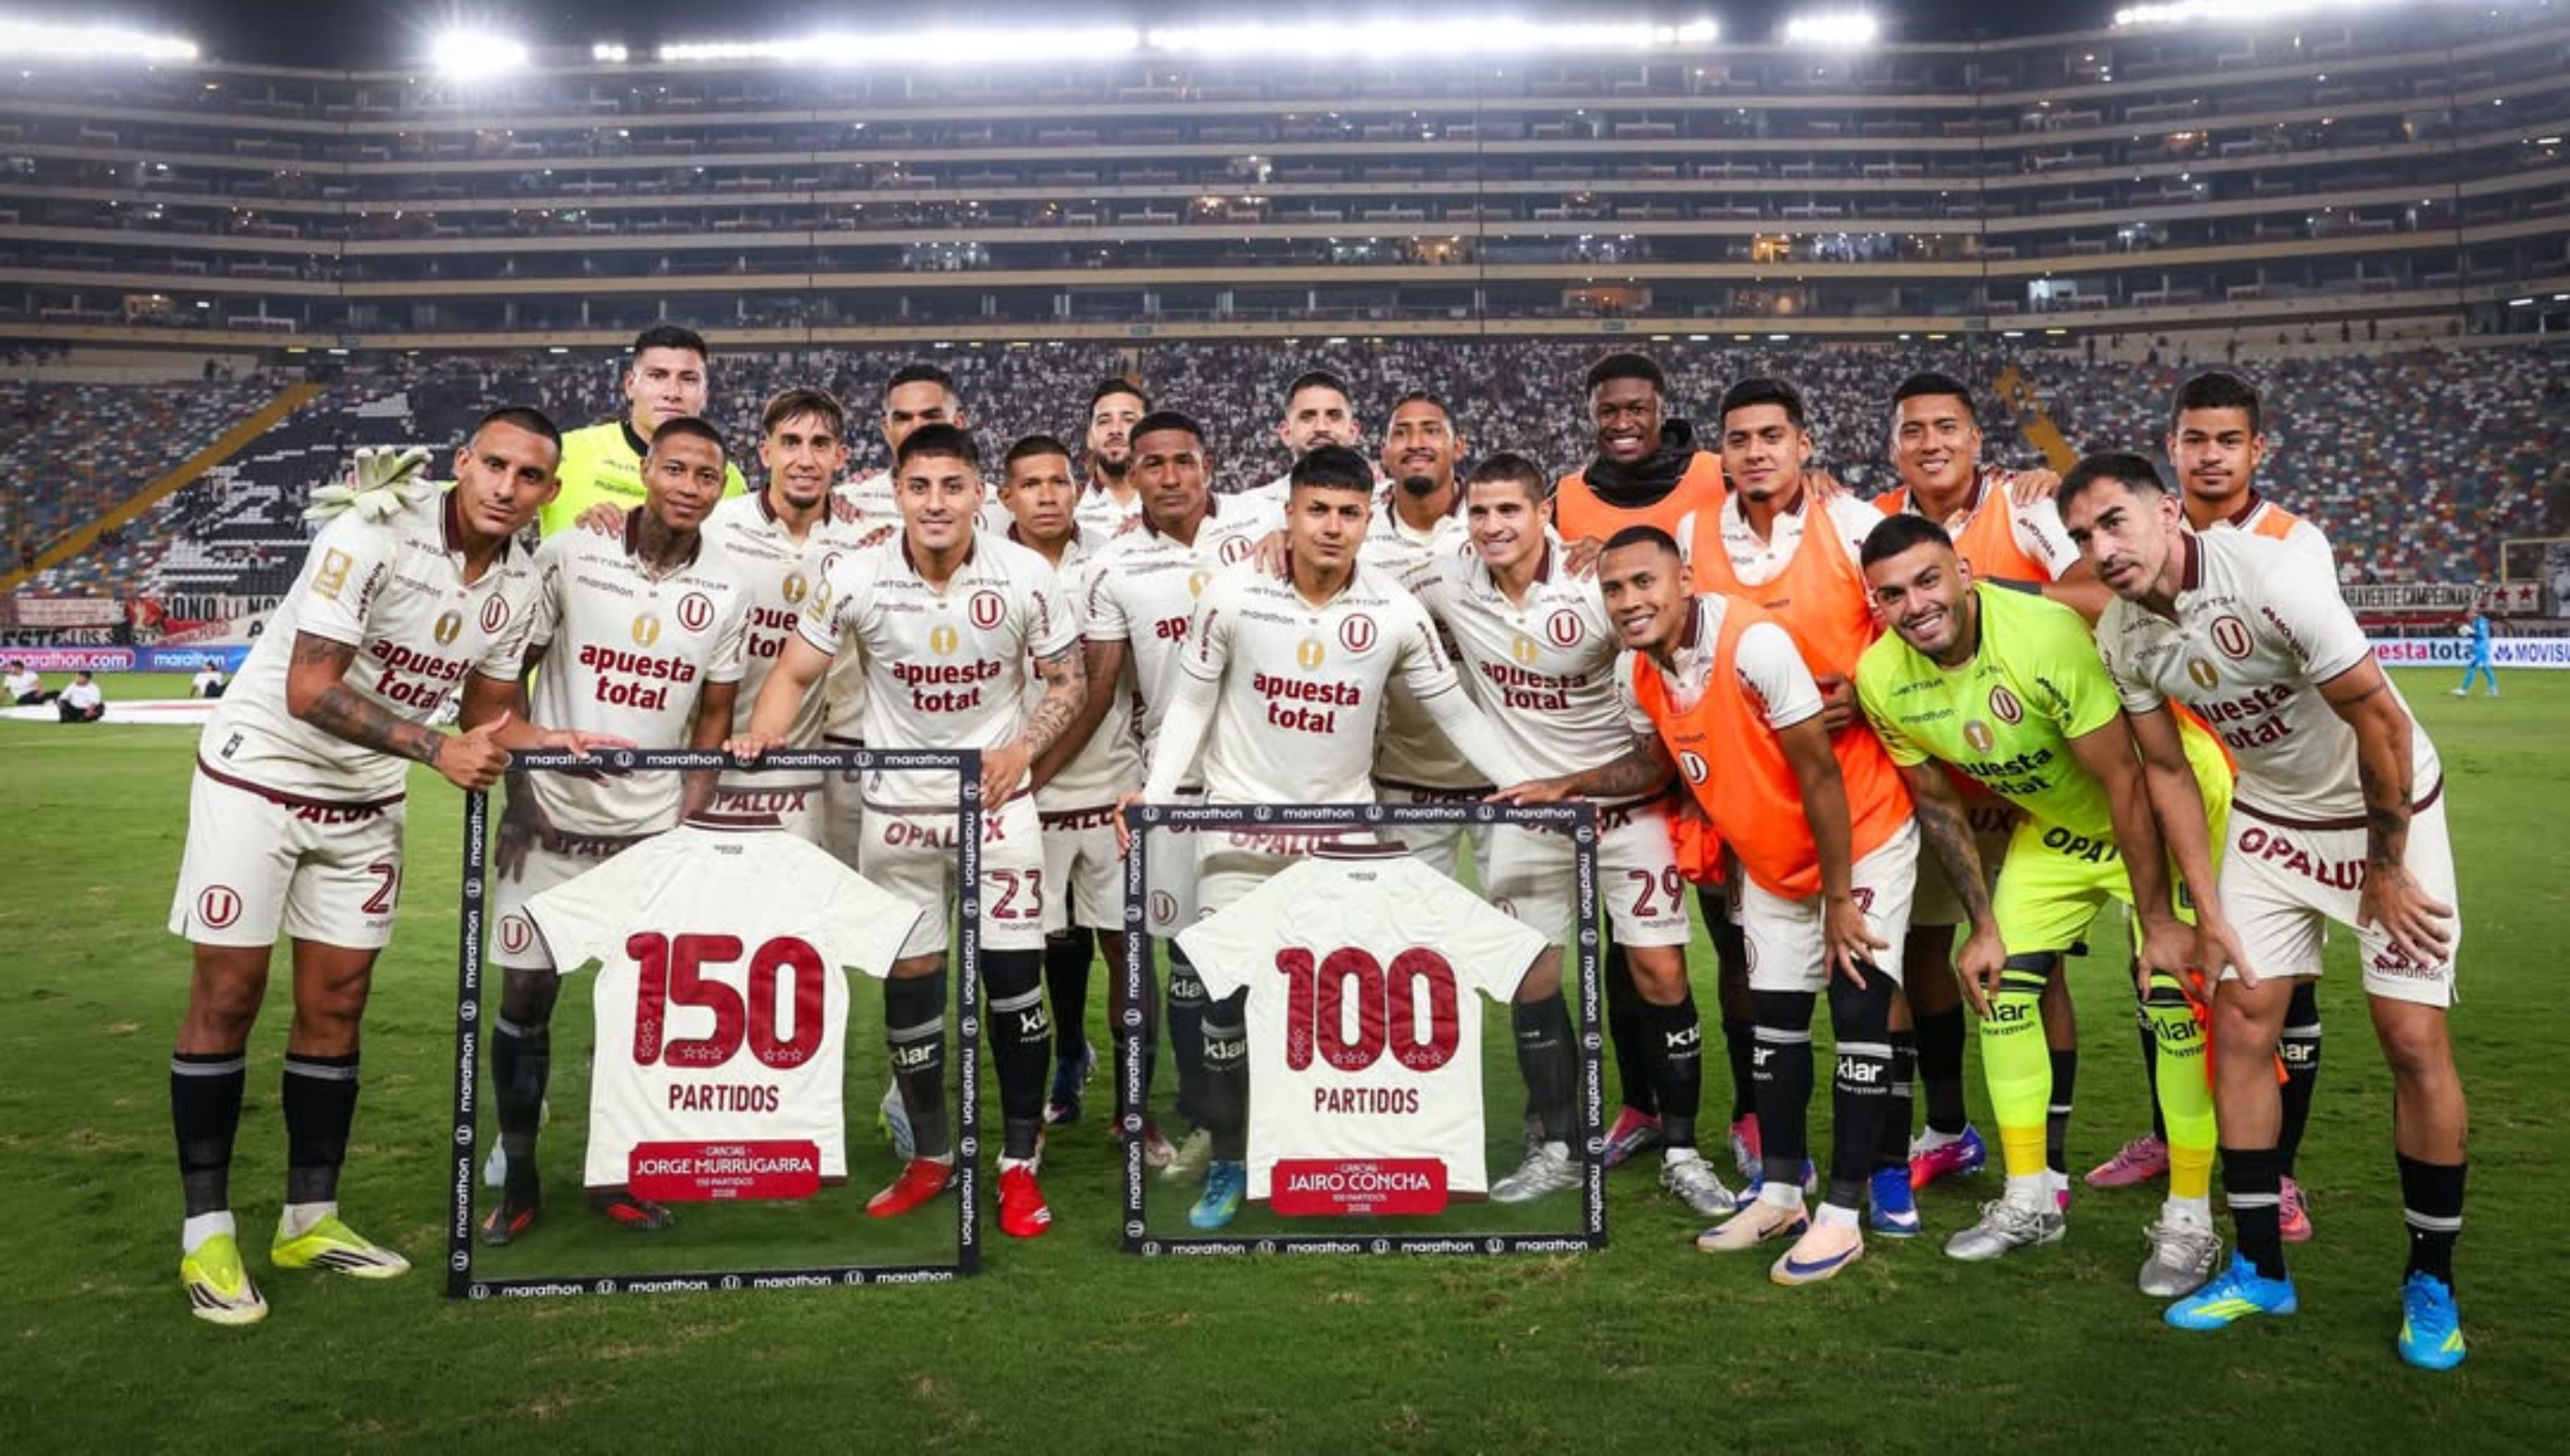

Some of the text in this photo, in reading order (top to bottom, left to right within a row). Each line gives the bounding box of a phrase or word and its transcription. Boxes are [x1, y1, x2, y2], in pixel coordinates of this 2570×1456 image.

[154, 651, 225, 669] marathon
[579, 644, 696, 683] apuesta
[892, 658, 1002, 686] apuesta
[1480, 661, 1588, 687] apuesta
[596, 676, 667, 711] total
[911, 687, 981, 713] total
[1253, 671, 1360, 706] apuesta
[1504, 686, 1571, 710] total
[2189, 682, 2296, 725] puesta
[1267, 702, 1335, 735] total
[2225, 714, 2293, 750] otal
[647, 754, 723, 765] marathon
[766, 754, 842, 765] marathon
[885, 754, 959, 765] marathon
[1171, 808, 1243, 819] marathon
[1283, 808, 1354, 818] marathon
[1394, 808, 1466, 818] marathon
[1506, 809, 1576, 818] marathon
[884, 822, 1005, 849] OPALX
[966, 814, 976, 886] marathon
[1129, 828, 1140, 894] marathon
[990, 869, 1042, 919] 23
[1580, 853, 1593, 919] marathon
[1628, 865, 1684, 917] 29
[466, 911, 478, 987] marathon
[965, 930, 975, 1004] marathon
[1127, 932, 1140, 998] marathon
[626, 932, 826, 1070] 150
[1584, 956, 1597, 1022] marathon
[1275, 947, 1459, 1072] 100
[1985, 999, 2030, 1022] lar
[462, 1033, 474, 1111] marathon
[964, 1048, 974, 1124] marathon
[1127, 1037, 1140, 1103] marathon
[1837, 1059, 1883, 1083] klar
[669, 1085, 780, 1112] PARTIDOS
[1314, 1087, 1419, 1114] PARTIDOS
[1588, 1060, 1600, 1126] marathon
[635, 1158, 813, 1175] JORGE MURRUGARRA
[1129, 1142, 1140, 1209] marathon
[1288, 1173, 1430, 1190] JAIRO CONCHA
[456, 1158, 469, 1237] marathon
[962, 1168, 973, 1245] marathon
[1591, 1165, 1602, 1232] marathon
[1172, 1244, 1245, 1255] marathon
[1287, 1242, 1360, 1254] marathon
[1402, 1241, 1474, 1253] marathon
[1515, 1239, 1588, 1251] marathon
[502, 1284, 583, 1297] marathon
[629, 1280, 708, 1293] marathon
[755, 1276, 831, 1288] marathon
[877, 1271, 953, 1283] marathon
